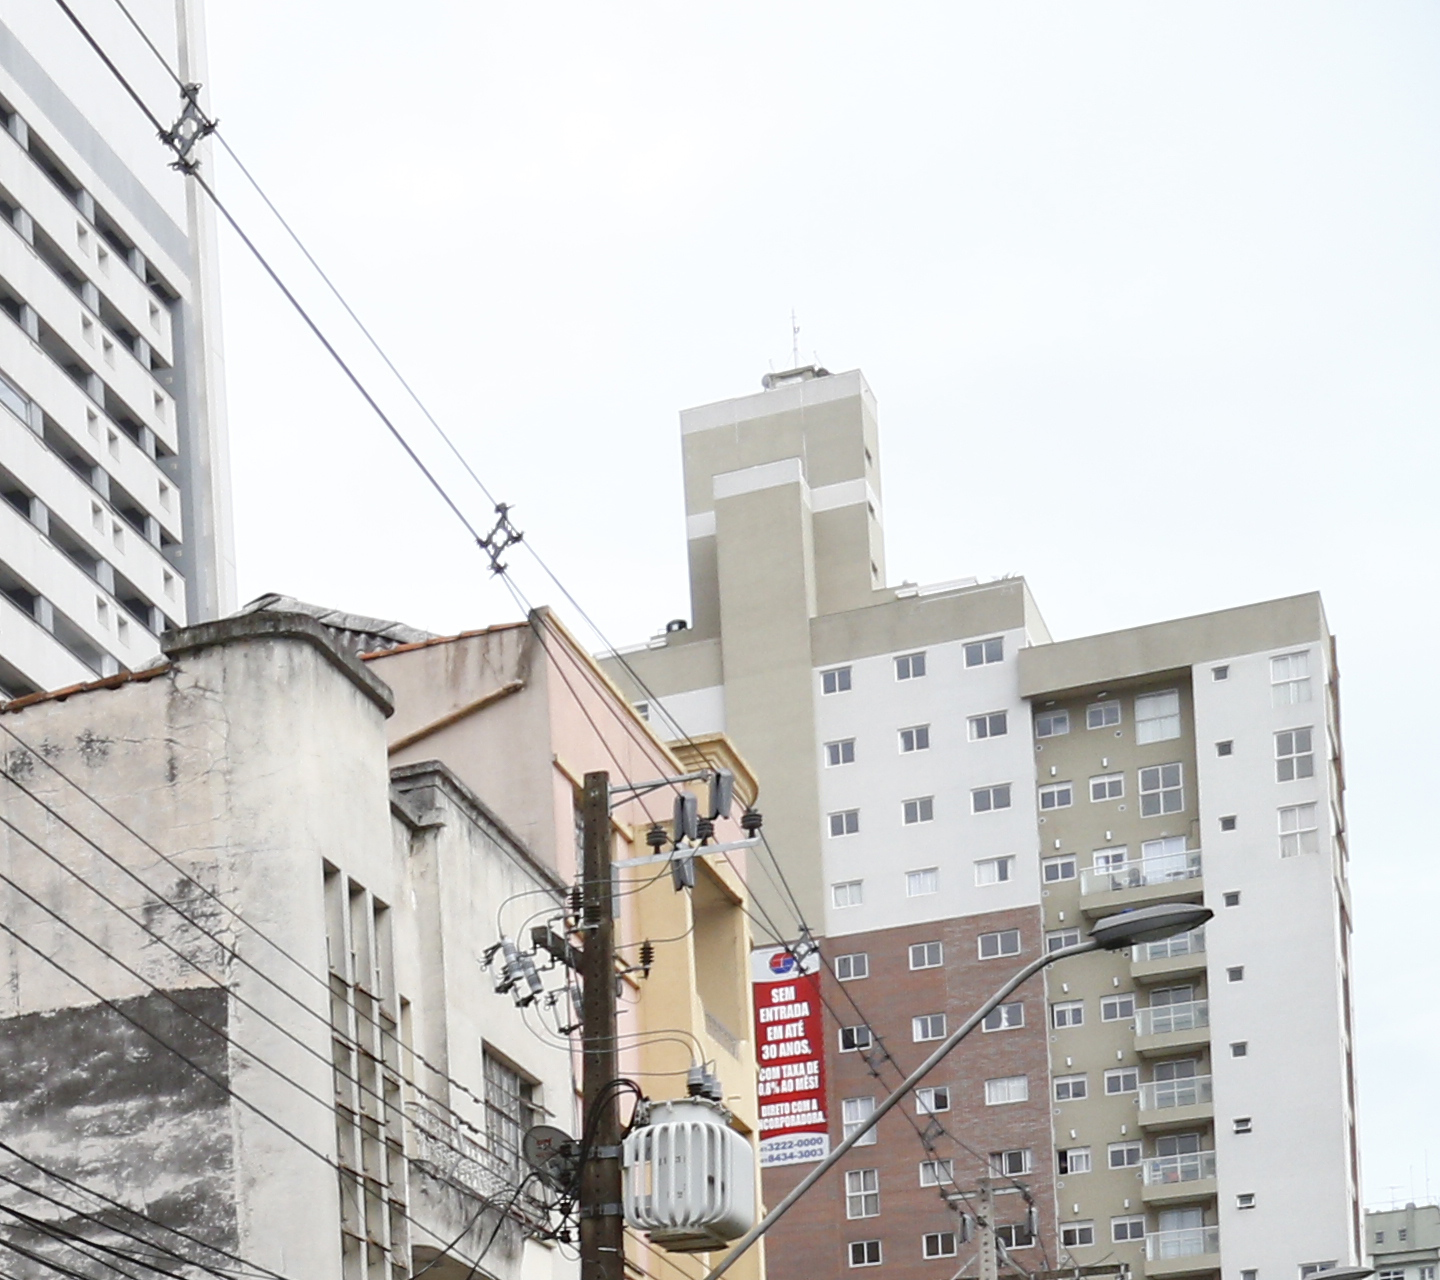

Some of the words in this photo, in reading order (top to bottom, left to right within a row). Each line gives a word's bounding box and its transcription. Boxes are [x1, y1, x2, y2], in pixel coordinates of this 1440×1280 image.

[771, 986, 796, 1003] SEM
[759, 1002, 810, 1023] ENTRADA
[767, 1025, 783, 1041] EM
[784, 1019, 805, 1038] ATÉ
[761, 1043, 777, 1060] 30
[781, 1062, 805, 1078] TAXA
[806, 1060, 819, 1074] DE
[761, 1102, 790, 1117] DIRETO
